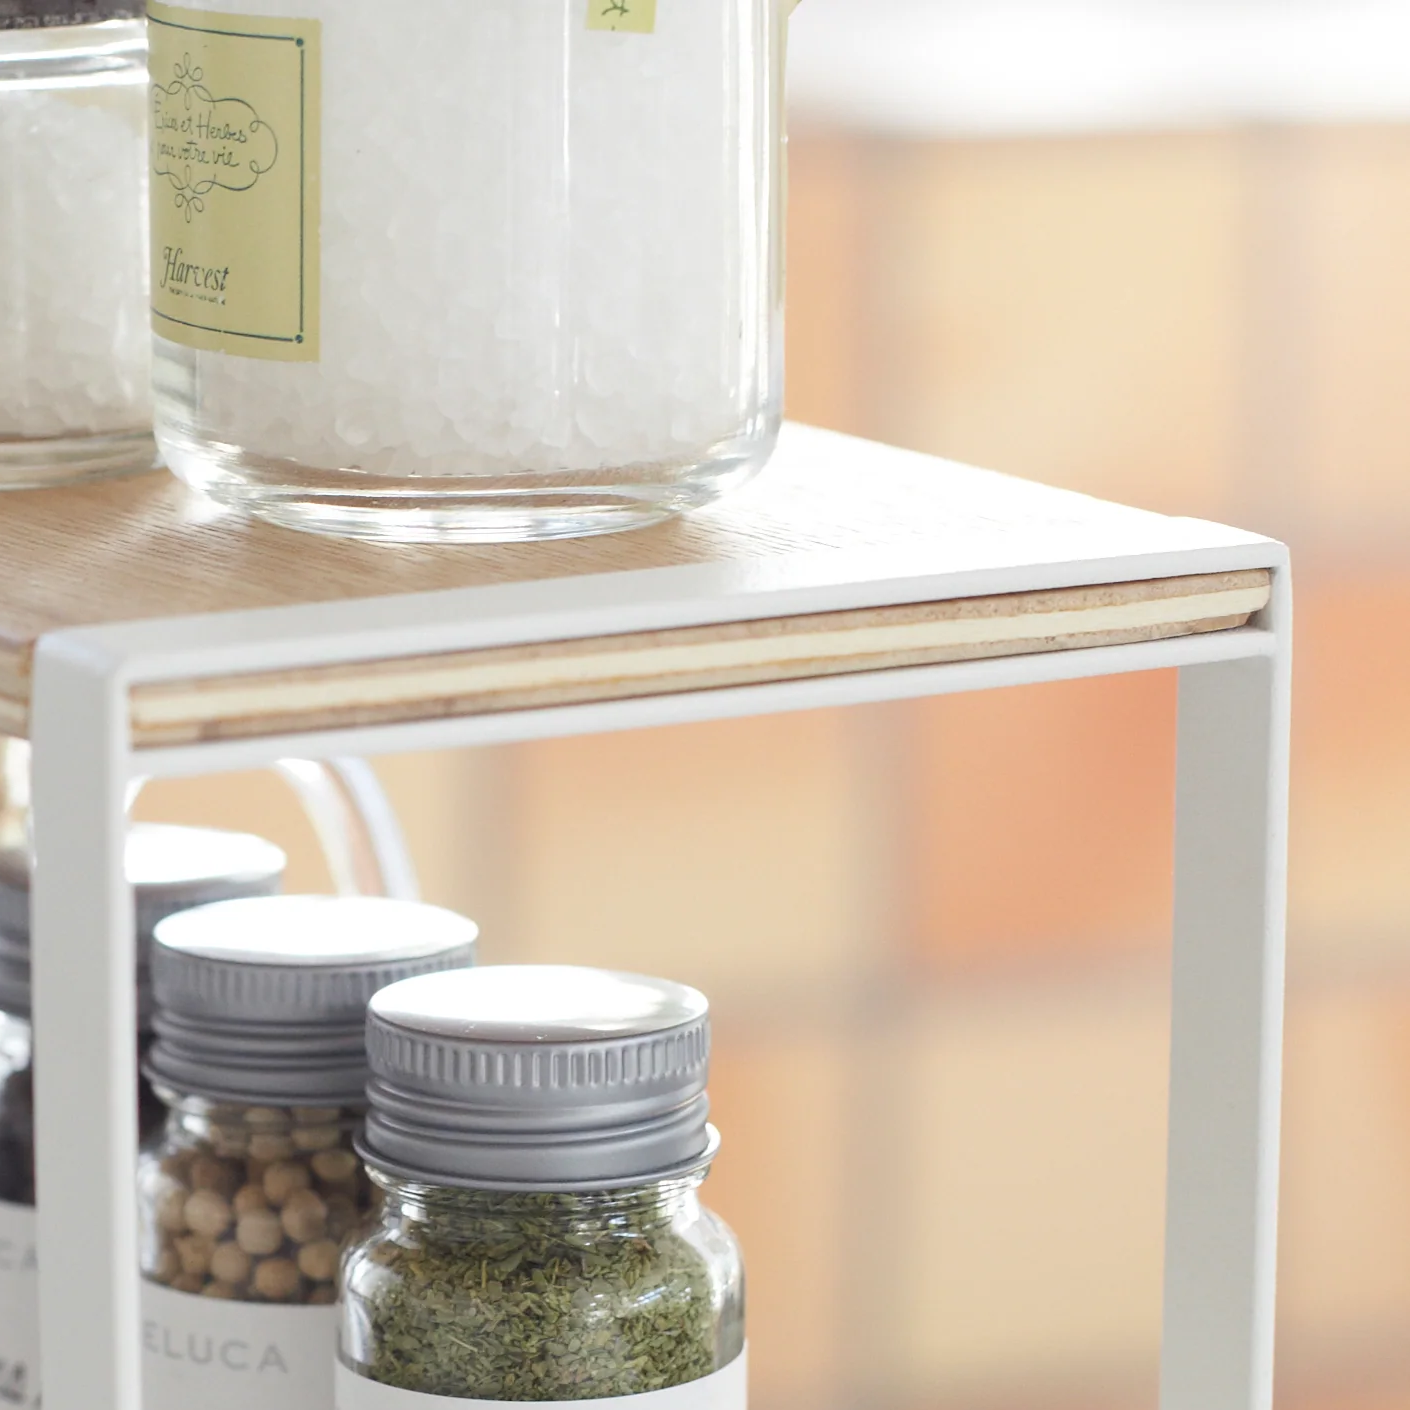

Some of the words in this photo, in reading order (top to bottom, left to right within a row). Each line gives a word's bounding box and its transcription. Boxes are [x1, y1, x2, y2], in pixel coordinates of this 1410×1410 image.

[196, 109, 248, 145] Herbes
[212, 145, 240, 168] vie
[159, 246, 230, 292] Harvest
[143, 1319, 289, 1375] ELUCA
